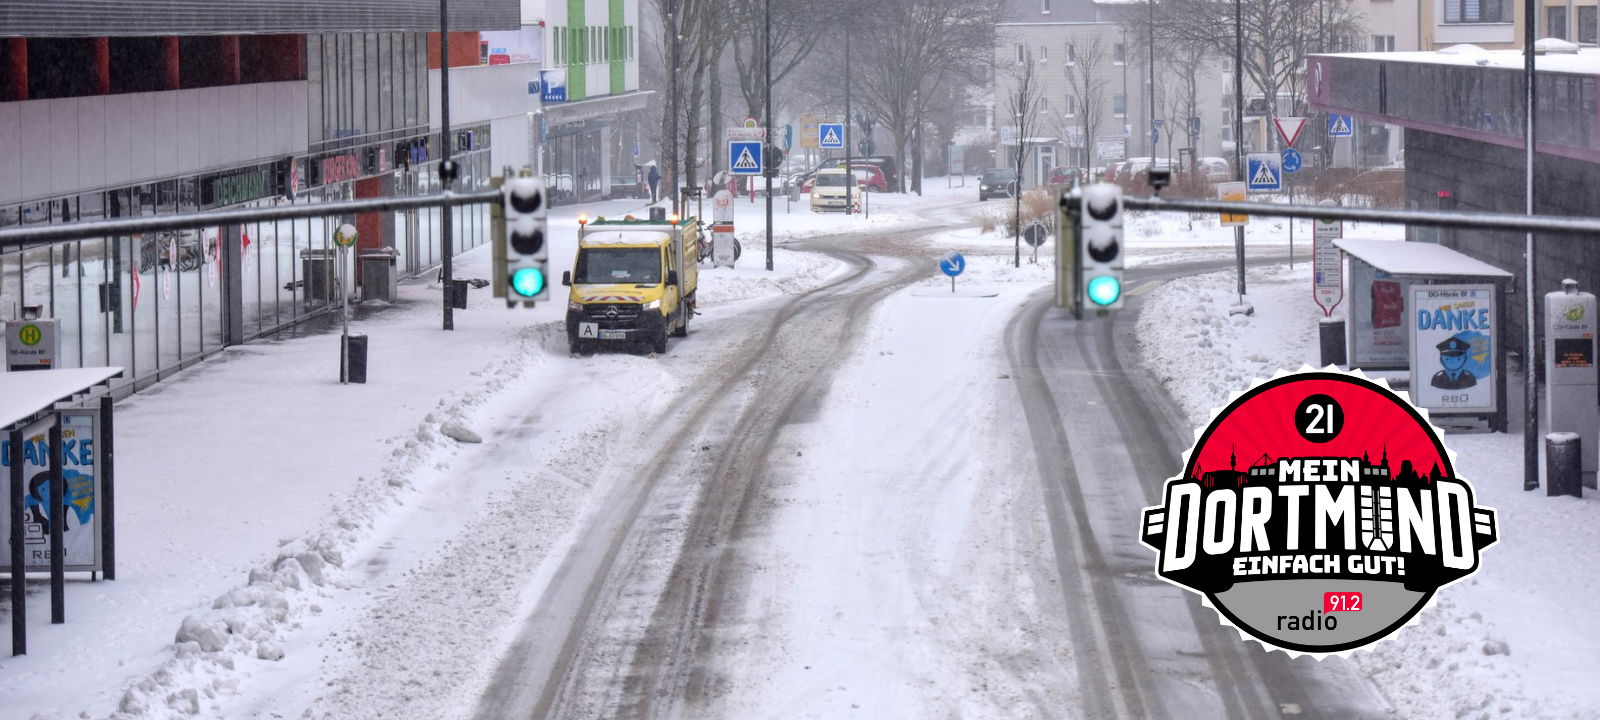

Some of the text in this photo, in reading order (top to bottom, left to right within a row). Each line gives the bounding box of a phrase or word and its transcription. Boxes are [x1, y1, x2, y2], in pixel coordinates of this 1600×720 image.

[217, 171, 264, 206] DEICHMANN
[583, 324, 593, 336] A
[1417, 308, 1490, 331] DANKE
